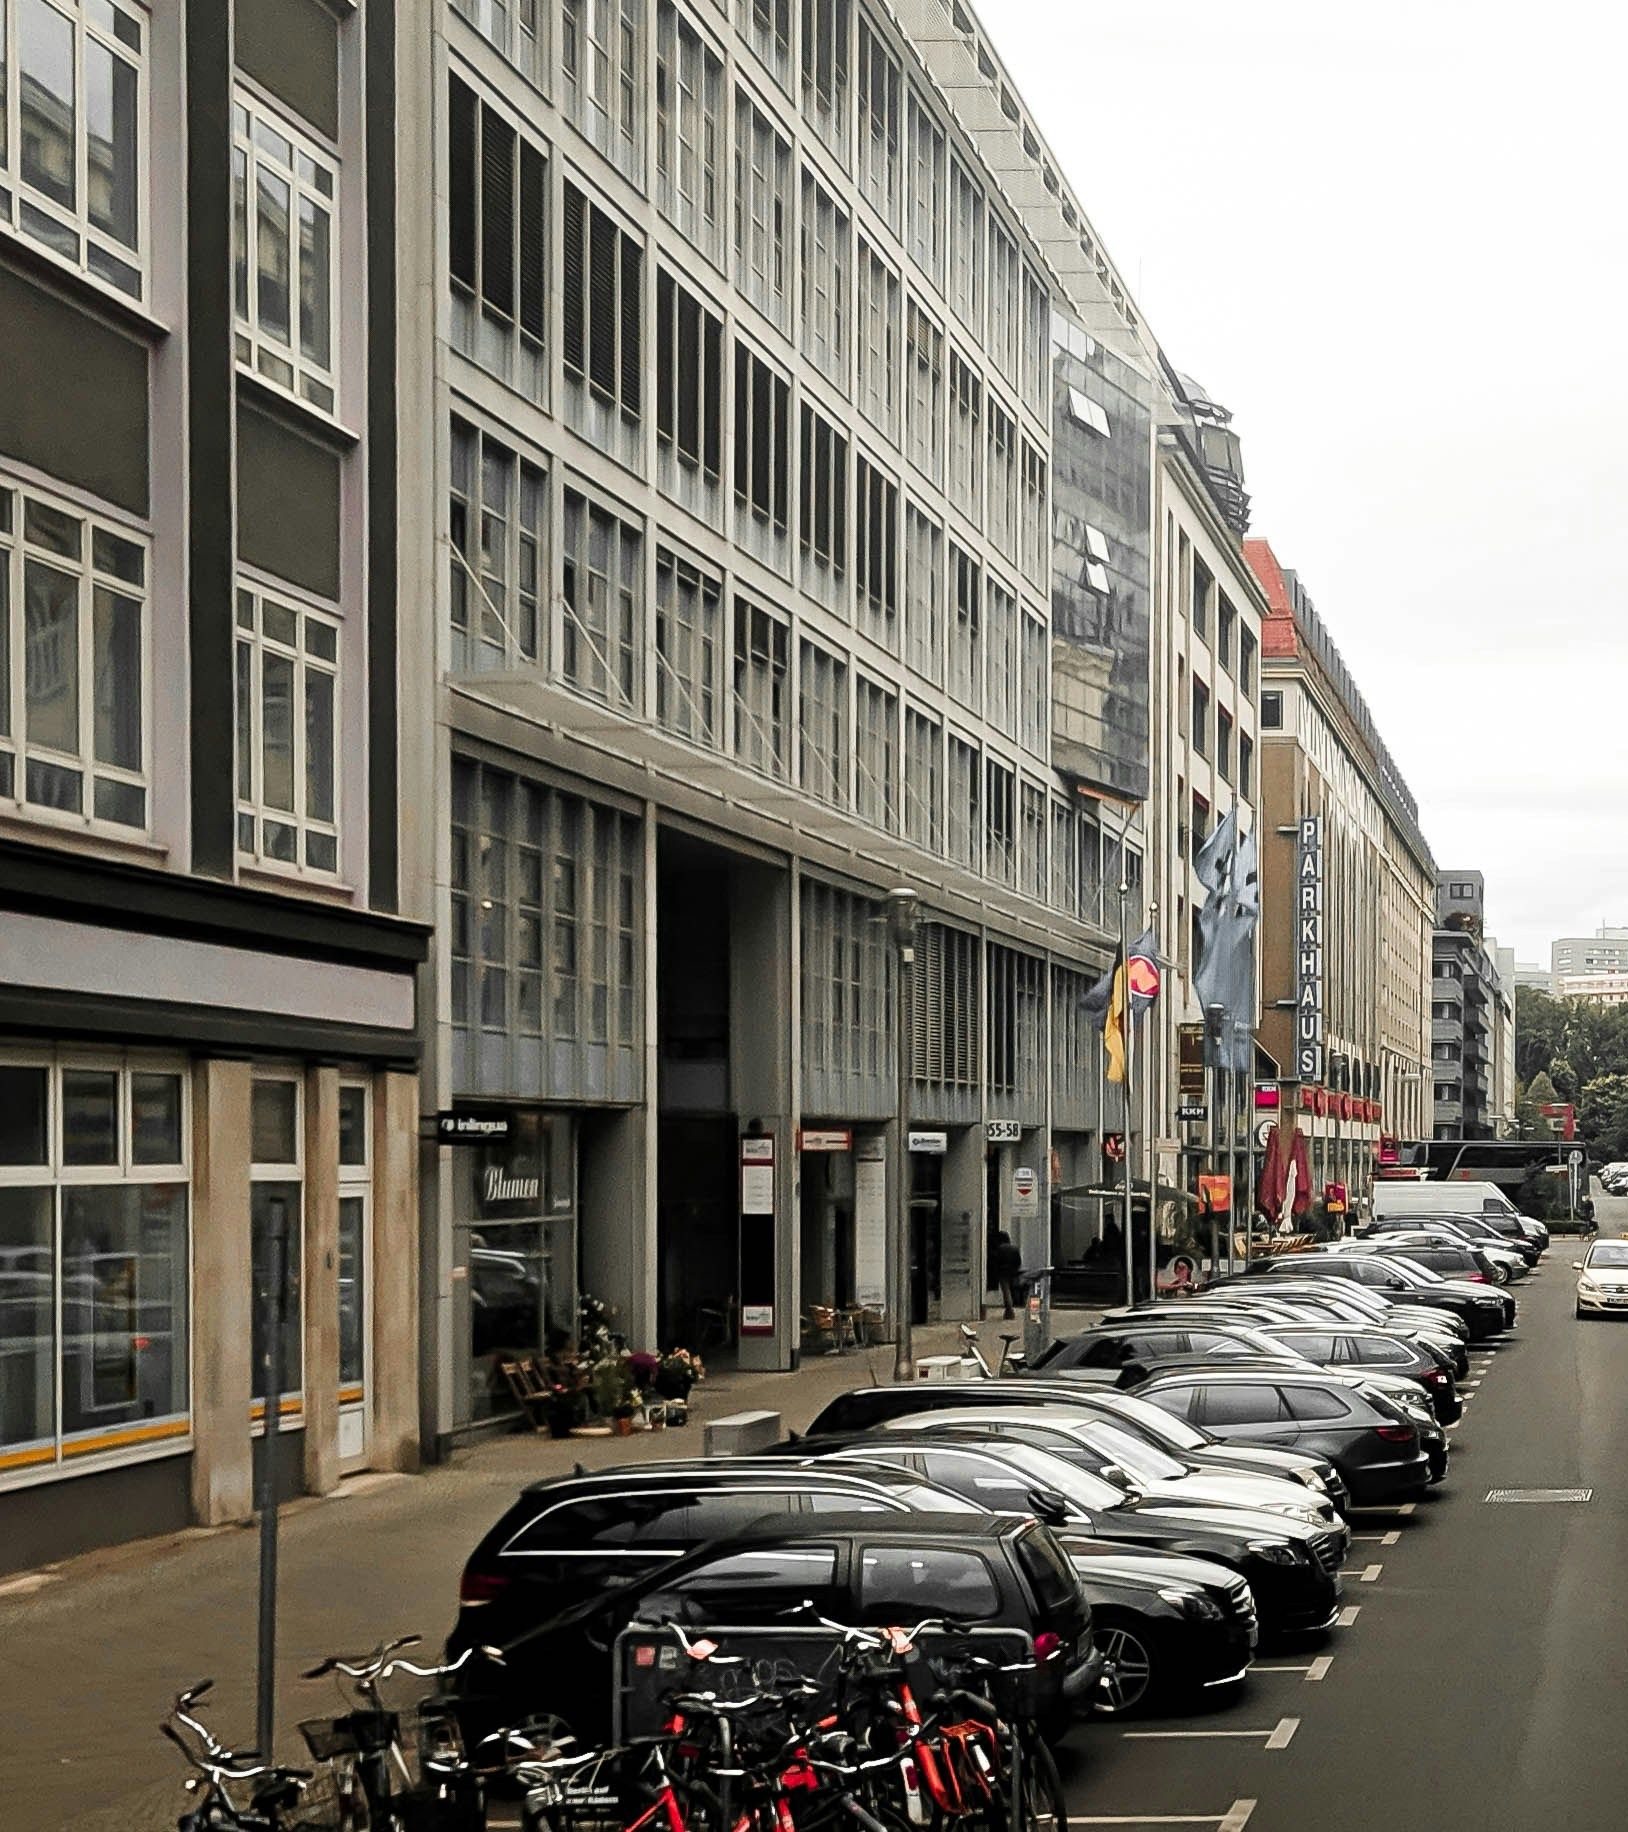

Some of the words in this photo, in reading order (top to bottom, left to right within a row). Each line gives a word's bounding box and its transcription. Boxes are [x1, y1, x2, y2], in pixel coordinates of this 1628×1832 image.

[1300, 820, 1318, 1074] PARKHAUS
[988, 1122, 1019, 1138] 55-58
[485, 1166, 539, 1200] Blumen
